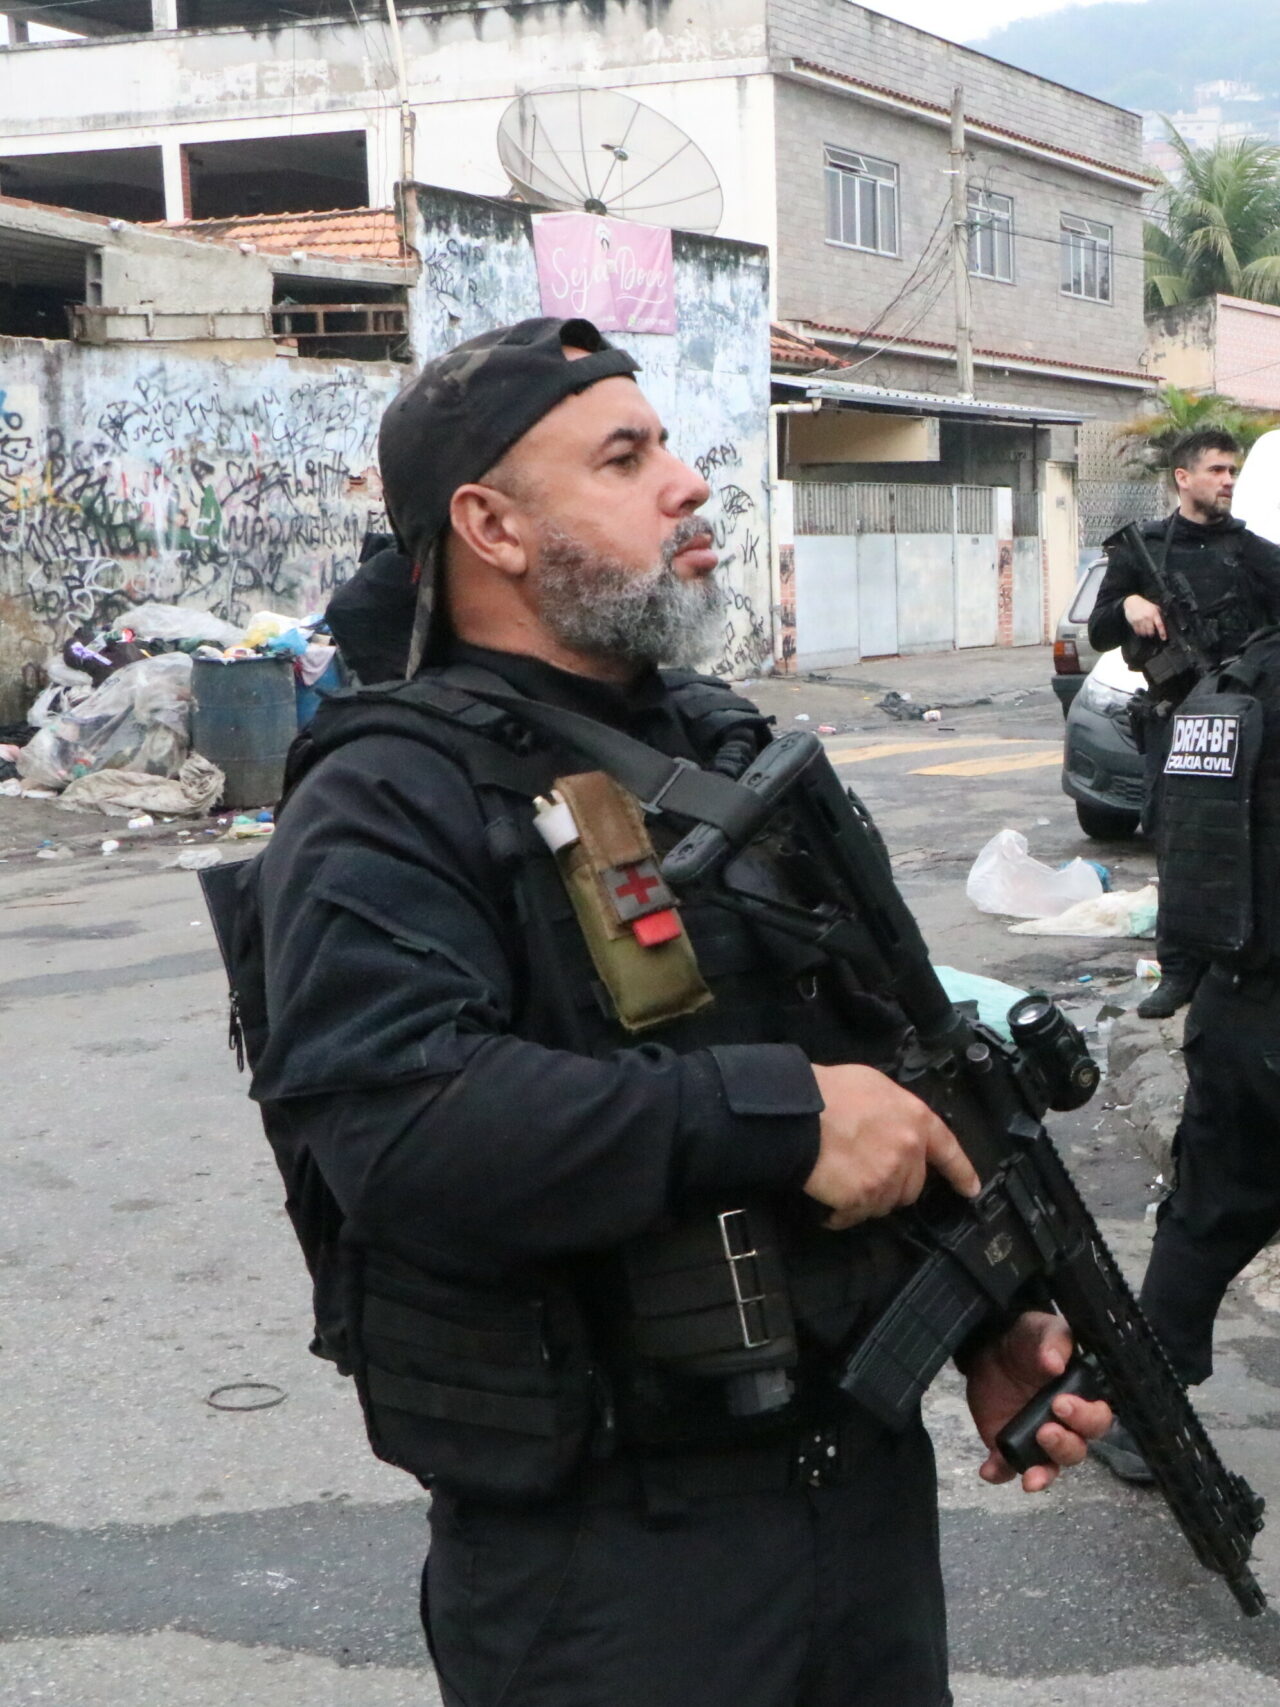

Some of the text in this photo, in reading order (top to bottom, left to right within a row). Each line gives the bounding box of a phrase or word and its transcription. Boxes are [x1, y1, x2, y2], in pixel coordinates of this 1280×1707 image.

[551, 246, 610, 313] Seja
[1173, 718, 1237, 753] DRFA-BF
[1203, 756, 1232, 772] CIVIL
